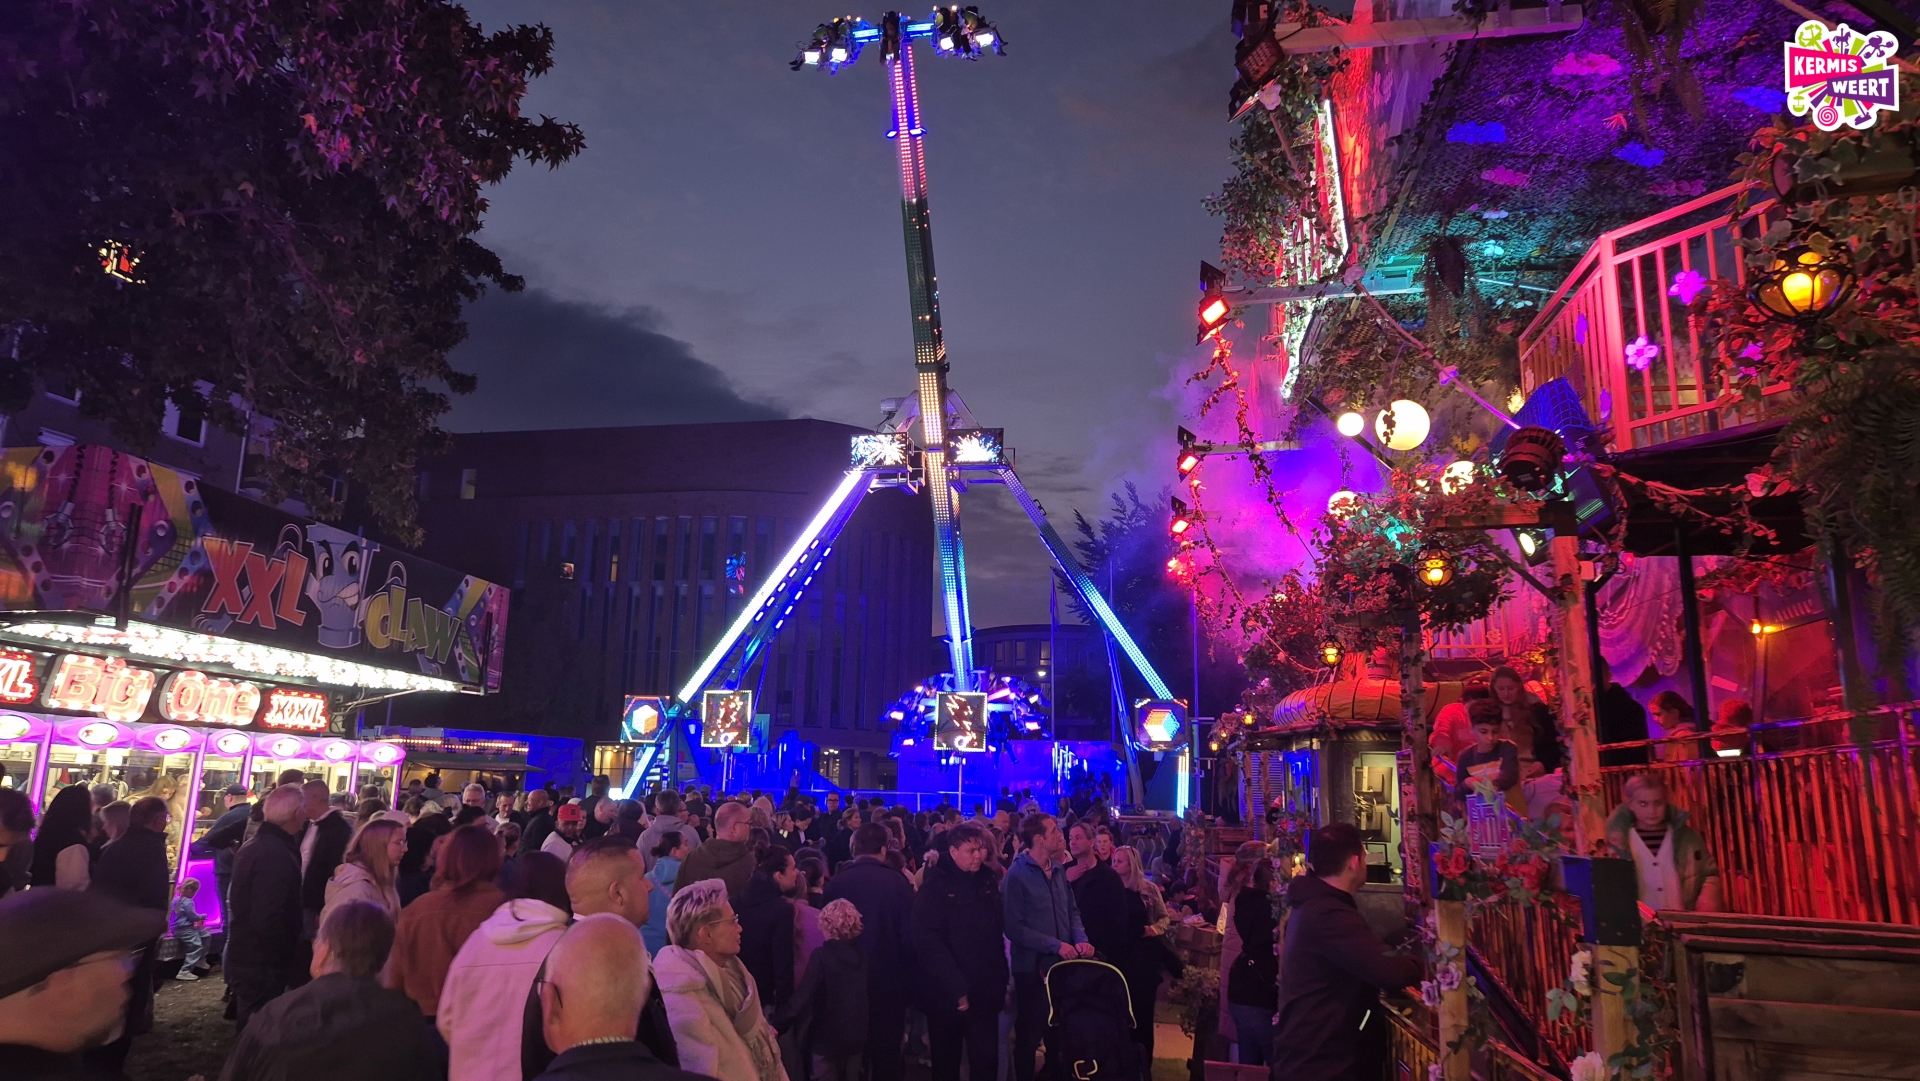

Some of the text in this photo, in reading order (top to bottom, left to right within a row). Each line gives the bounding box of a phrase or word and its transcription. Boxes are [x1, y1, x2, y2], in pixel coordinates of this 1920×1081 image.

[201, 536, 309, 630] XXL
[53, 659, 257, 721] Big One
